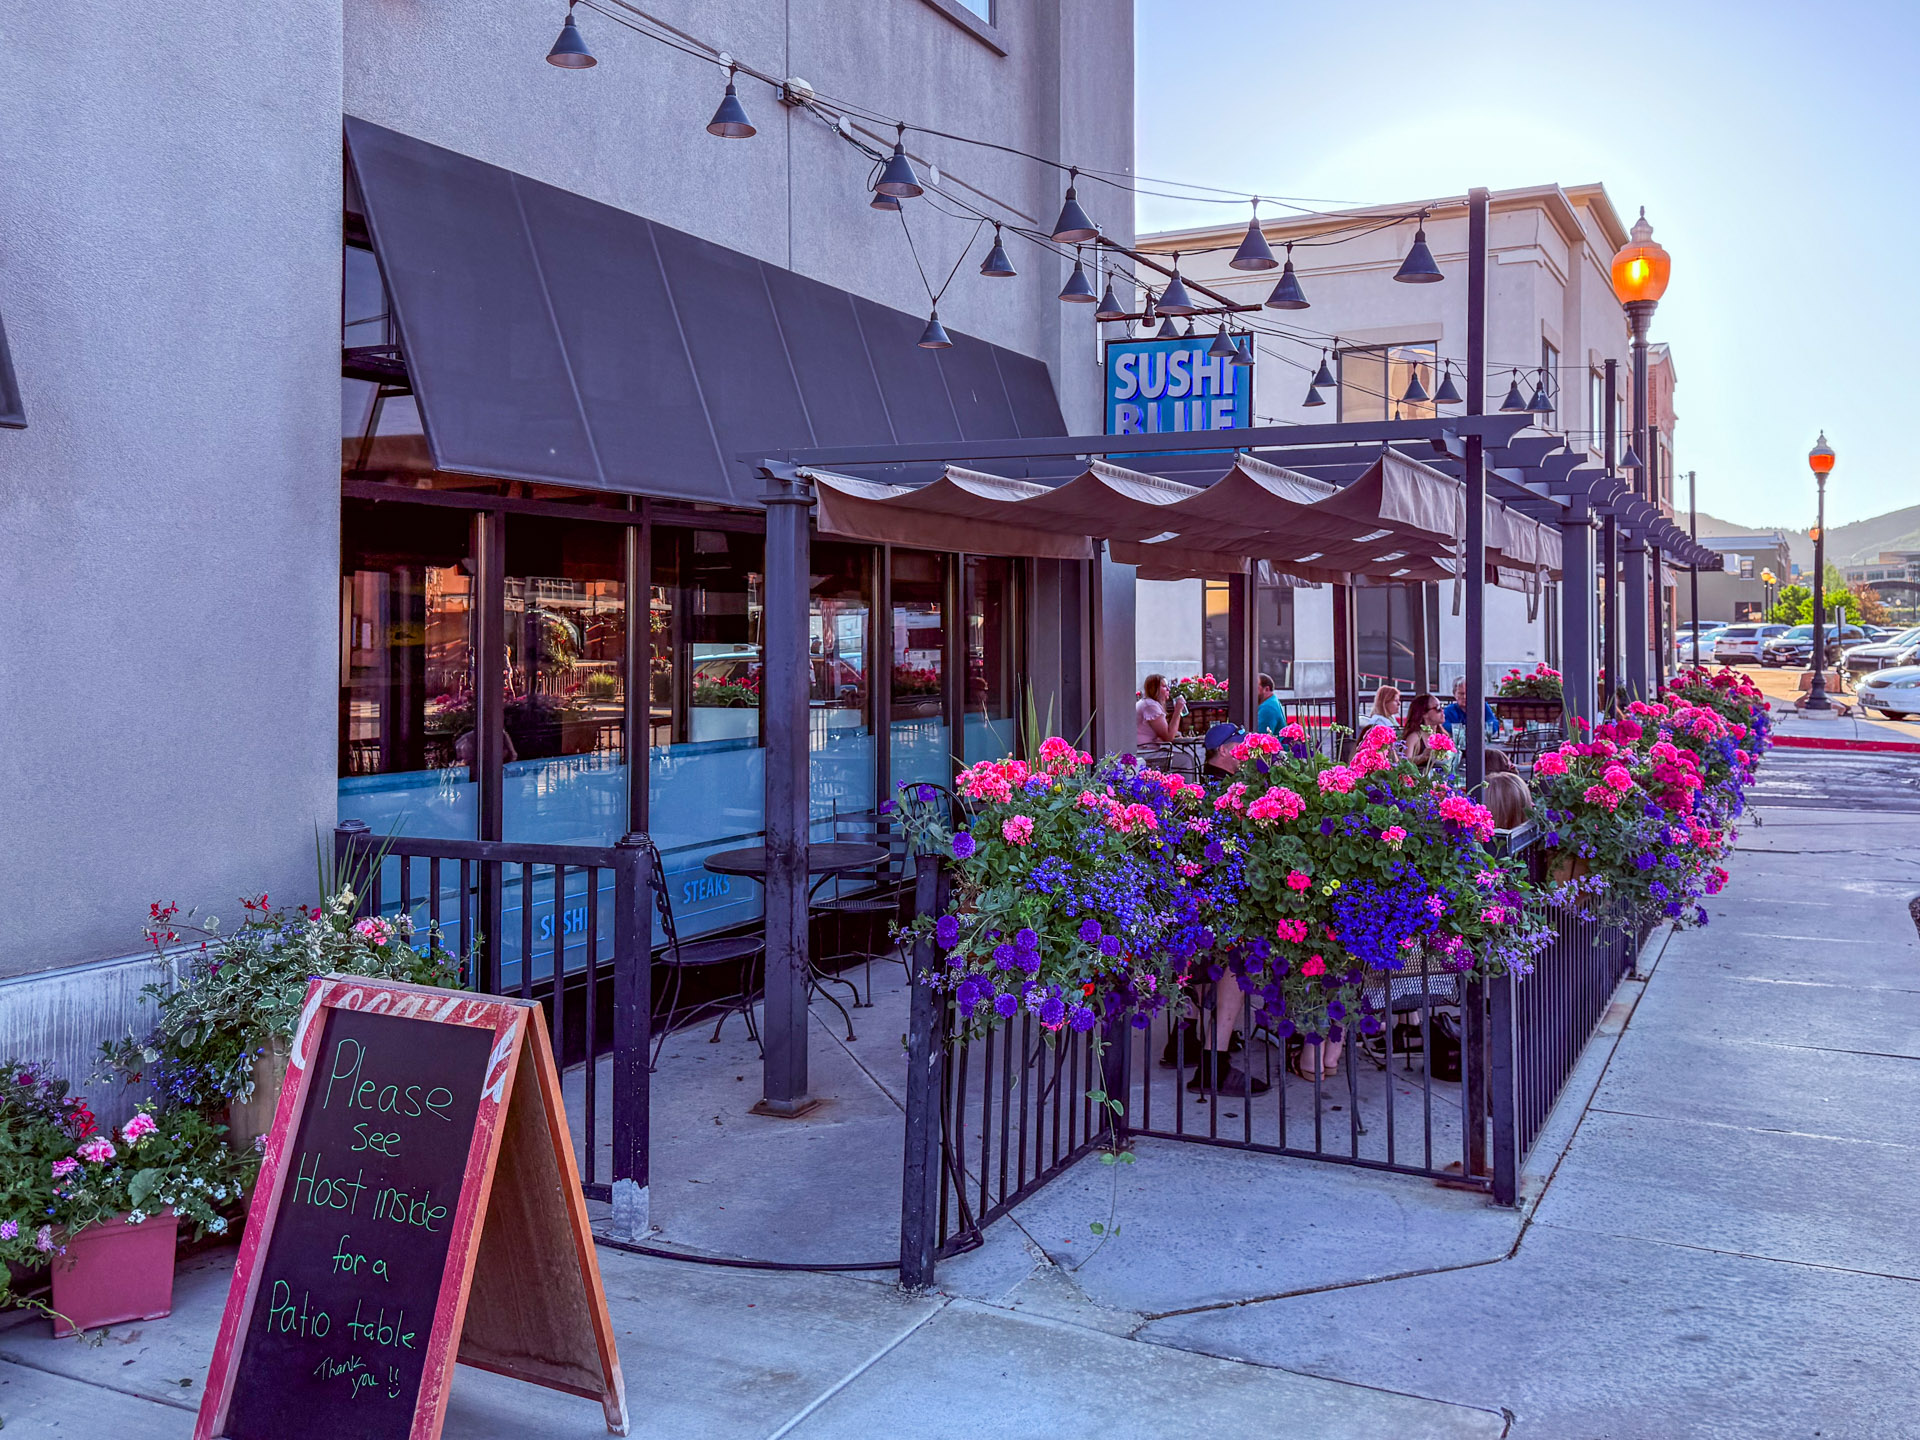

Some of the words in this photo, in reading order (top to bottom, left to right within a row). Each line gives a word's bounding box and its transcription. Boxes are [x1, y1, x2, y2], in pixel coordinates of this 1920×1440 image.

[1114, 349, 1236, 399] SUSHI
[683, 874, 730, 904] STEAKS
[323, 1038, 454, 1122] Please
[293, 1152, 368, 1215] Host
[373, 1177, 447, 1232] inside
[333, 1234, 367, 1275] for
[372, 1259, 389, 1282] a
[267, 1279, 331, 1338] Patio
[313, 1355, 366, 1381] Thank
[351, 1373, 379, 1399] you
